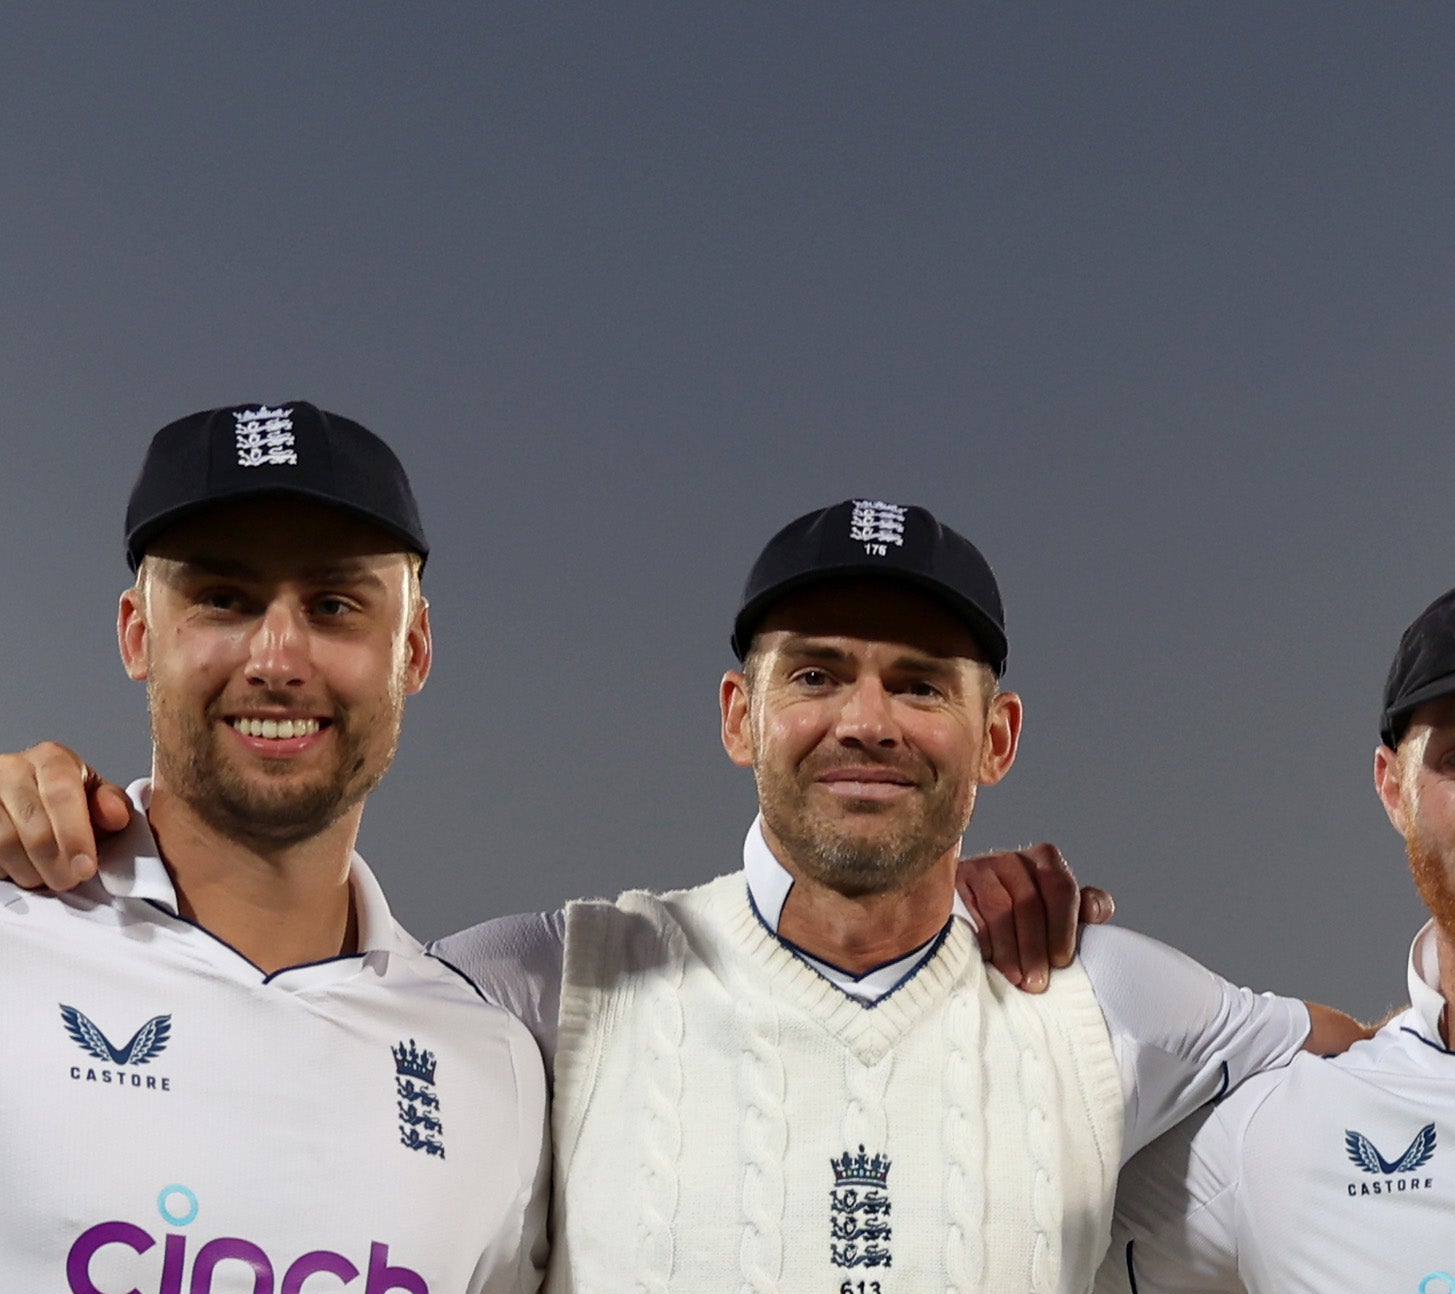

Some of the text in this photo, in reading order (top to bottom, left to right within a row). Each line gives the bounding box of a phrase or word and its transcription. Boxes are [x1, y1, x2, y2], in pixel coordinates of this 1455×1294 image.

[864, 543, 888, 557] 176
[70, 1066, 170, 1092] CASTORE
[1347, 1178, 1433, 1197] CASTORE
